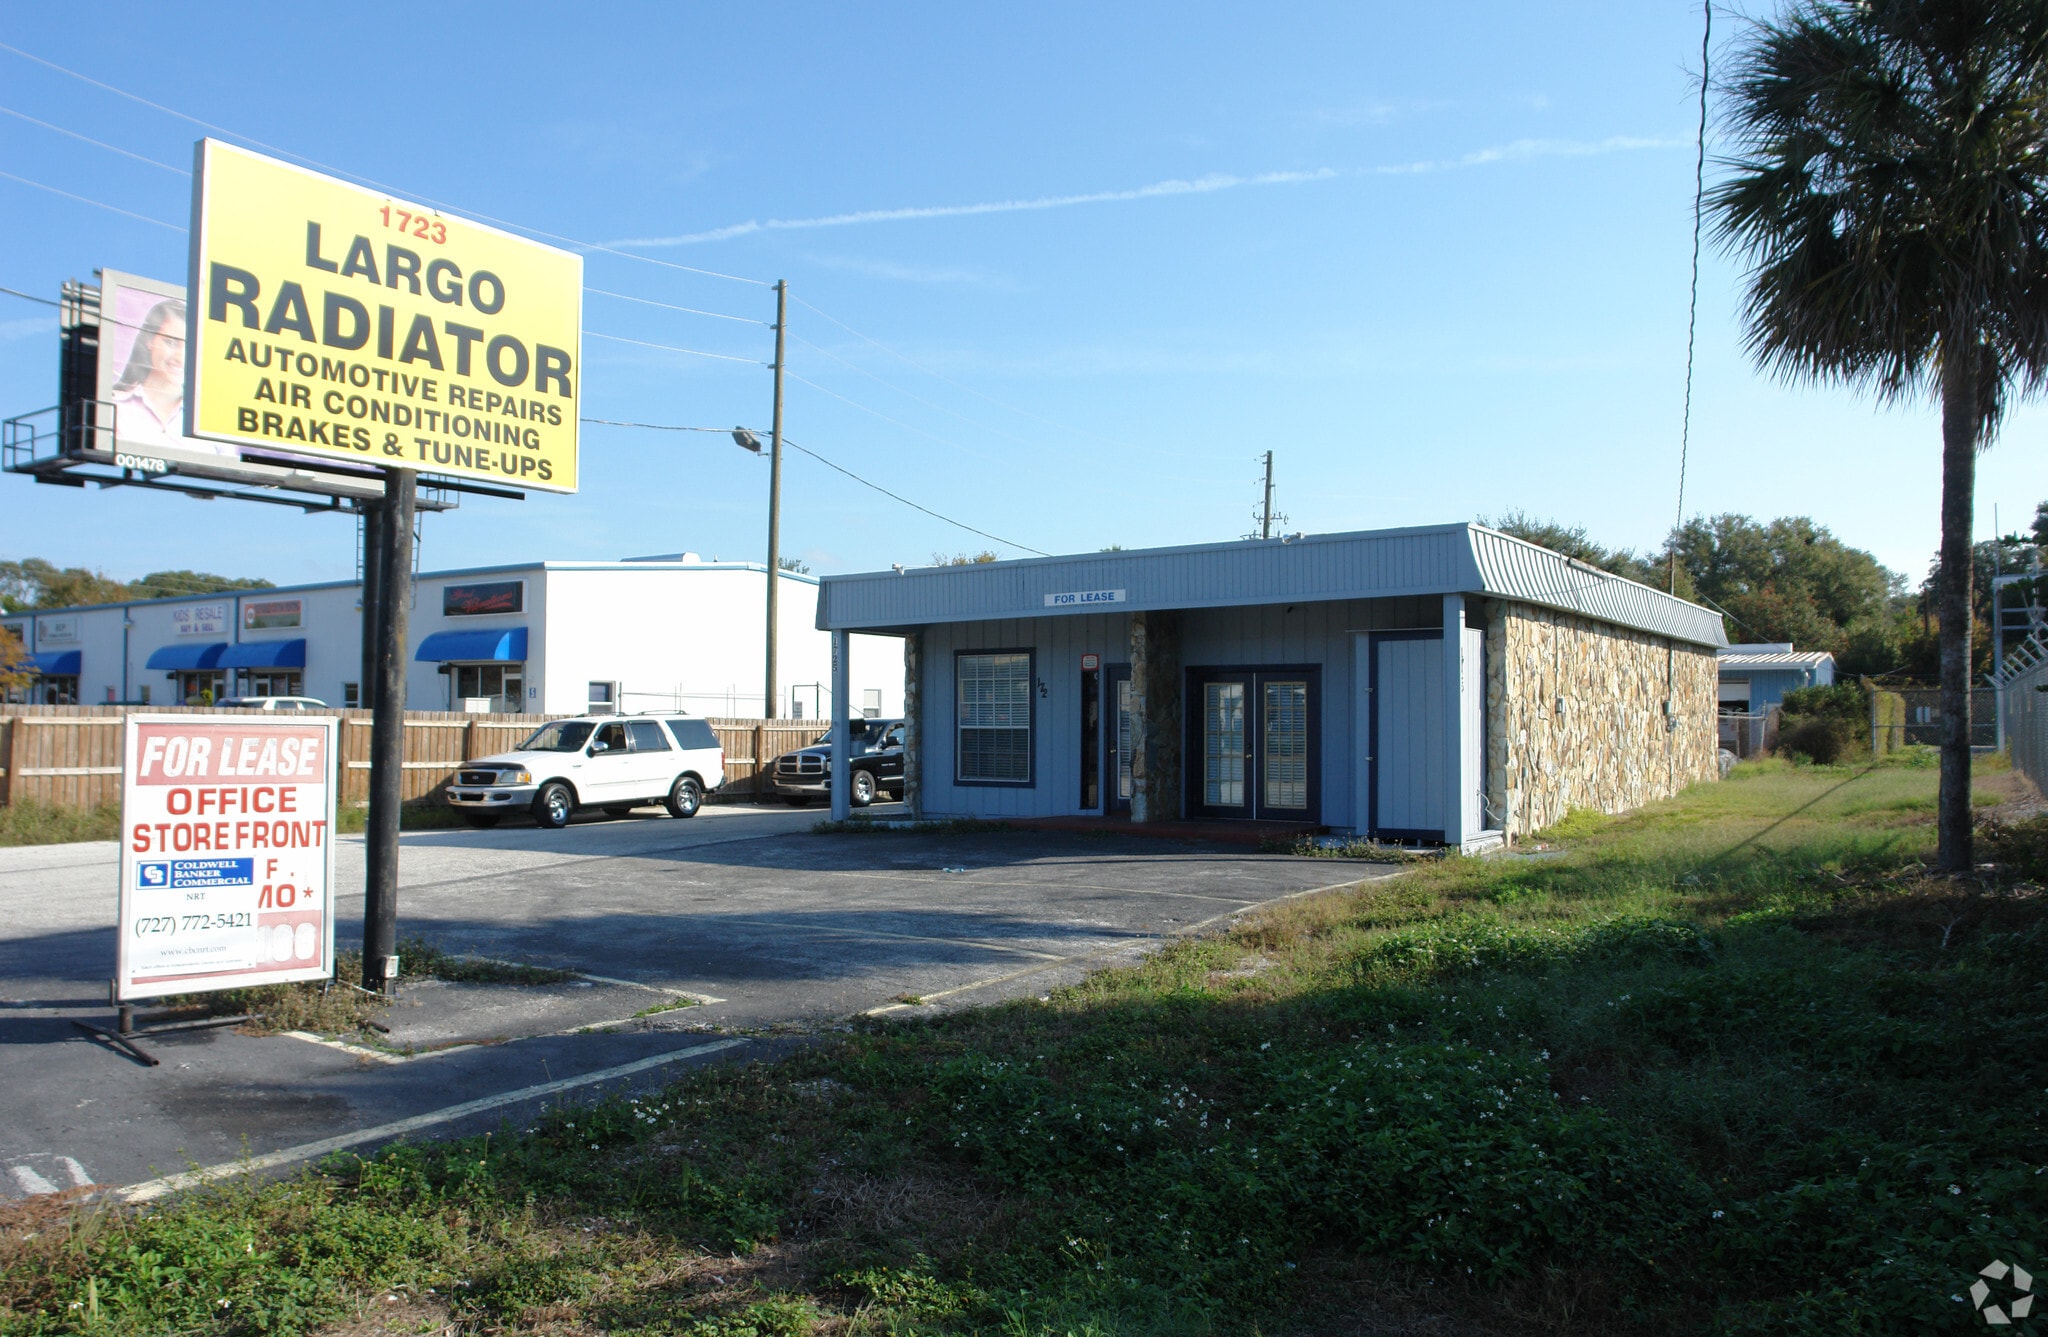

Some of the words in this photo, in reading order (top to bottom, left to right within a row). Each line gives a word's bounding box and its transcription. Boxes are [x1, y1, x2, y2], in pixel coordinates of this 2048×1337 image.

[378, 204, 448, 245] 1723
[305, 219, 506, 316] LARGO
[208, 260, 573, 399] RADIATOR
[224, 336, 437, 402] AUTOMOTIVE
[448, 383, 563, 427] REPAIRS
[254, 376, 312, 410] AIR
[323, 389, 541, 451] CONDITIONING
[237, 405, 372, 451] BRAKES
[382, 432, 405, 457] &
[414, 437, 553, 481] TUNE-UPS
[115, 452, 168, 473] 001478
[1054, 594, 1076, 604] FOR
[1080, 591, 1115, 602] LEASE
[173, 608, 190, 622] KIDS
[195, 606, 223, 620] RESALE
[139, 736, 212, 777] FOR
[217, 736, 319, 777] LEASE
[166, 786, 297, 816] OFFICE
[132, 820, 327, 853] STOREFRONT
[174, 860, 239, 870] COLDWELL
[174, 869, 222, 879] BANKER
[173, 877, 251, 888] COMMERCIAL
[186, 892, 206, 901] NRT
[135, 915, 177, 938] (727)
[182, 912, 252, 931] 772-5421
